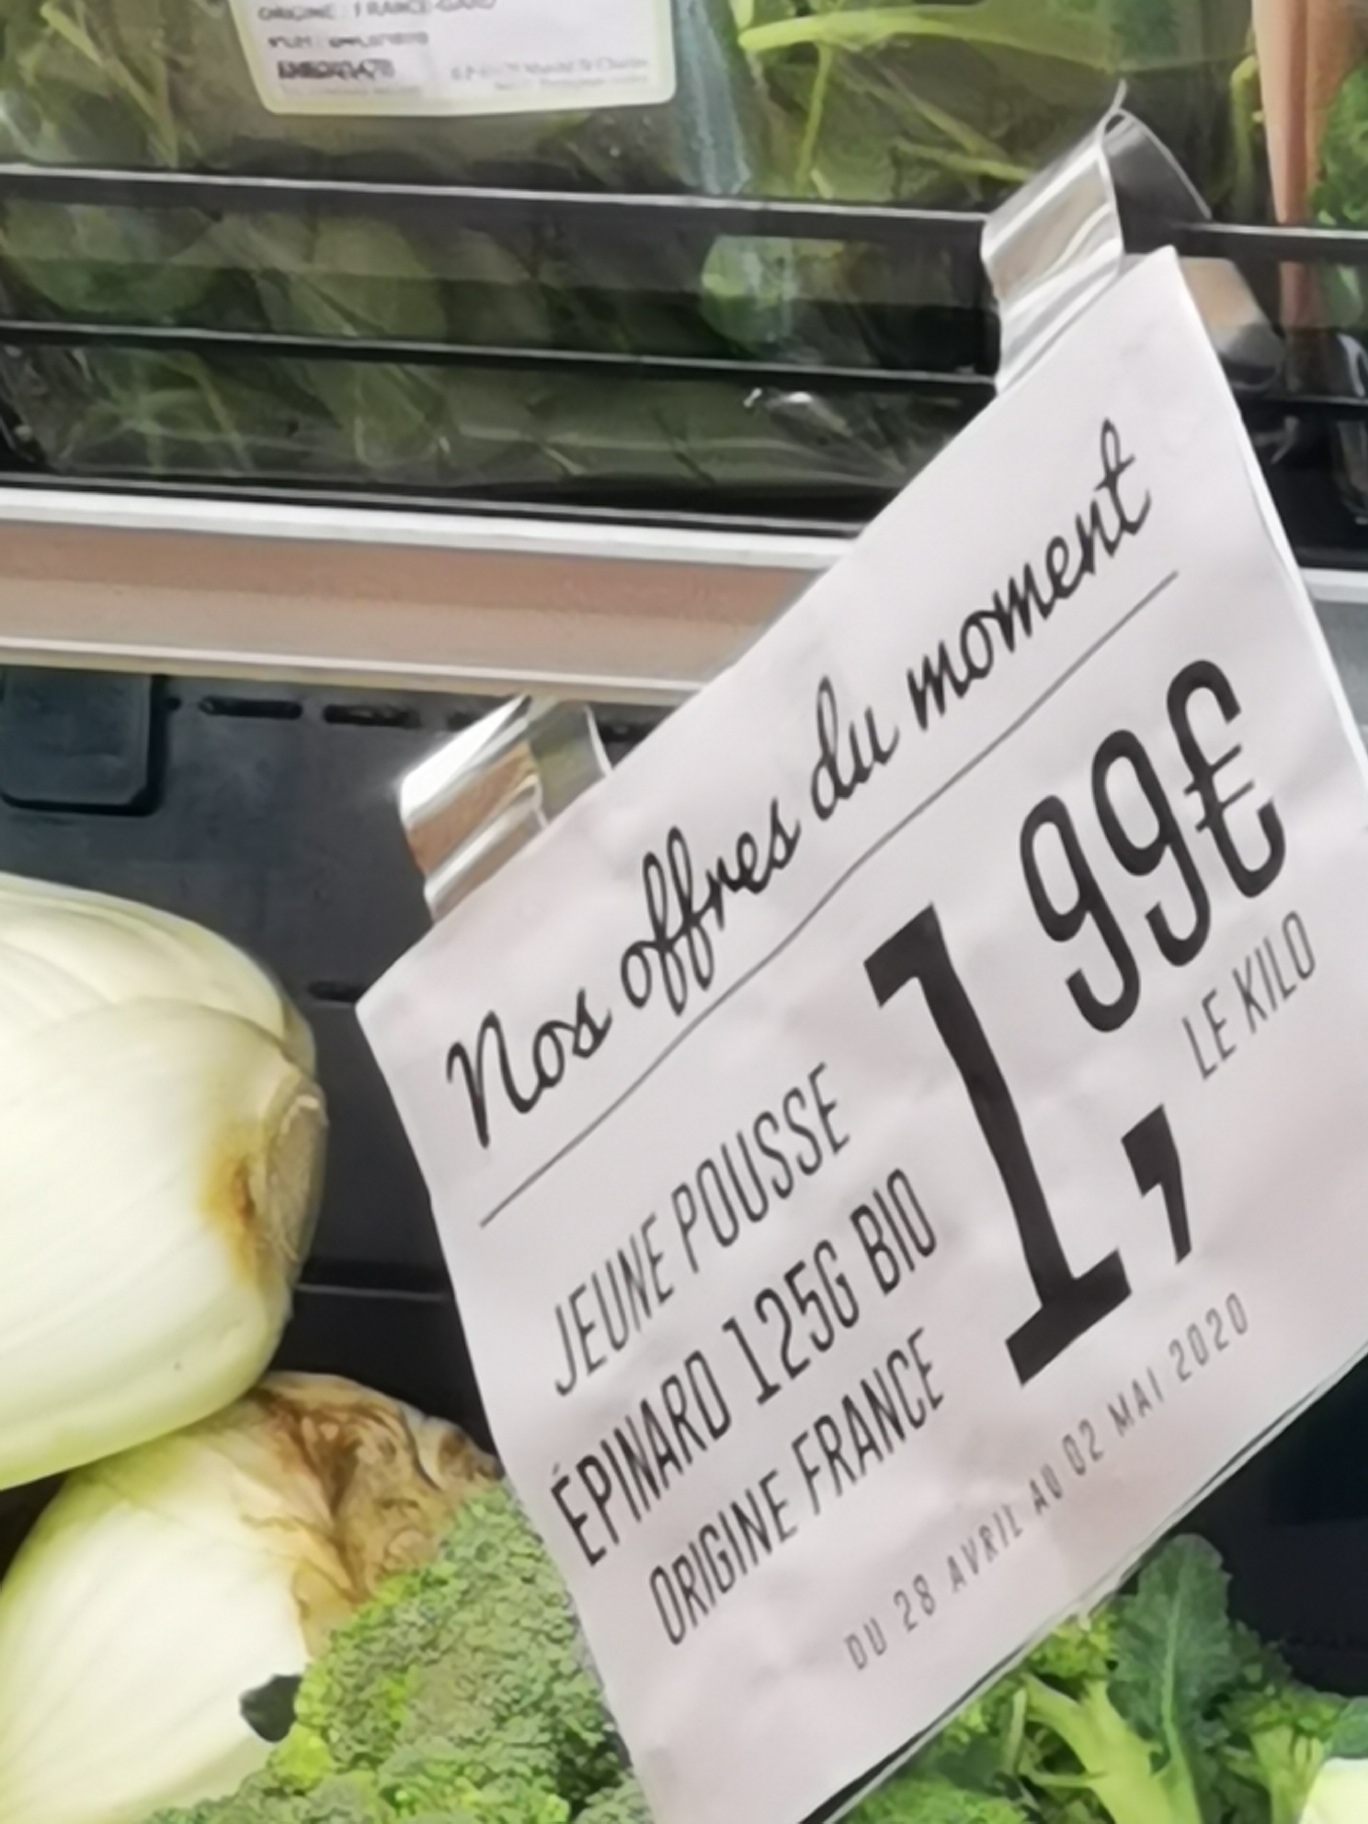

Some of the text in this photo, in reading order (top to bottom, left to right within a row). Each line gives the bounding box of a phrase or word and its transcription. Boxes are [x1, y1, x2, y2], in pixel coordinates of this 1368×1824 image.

[446, 417, 1152, 1148] Nos offres du moment
[1182, 910, 1317, 1081] LE KILO
[550, 1168, 938, 1567] ÉPINARD 125G BIO
[554, 1062, 851, 1397] JEUNE POUSSE
[648, 1327, 945, 1646] ORIGINE FRANCE
[845, 1291, 1250, 1672] DU 28 AVRIL AU 02 MAI 2020
